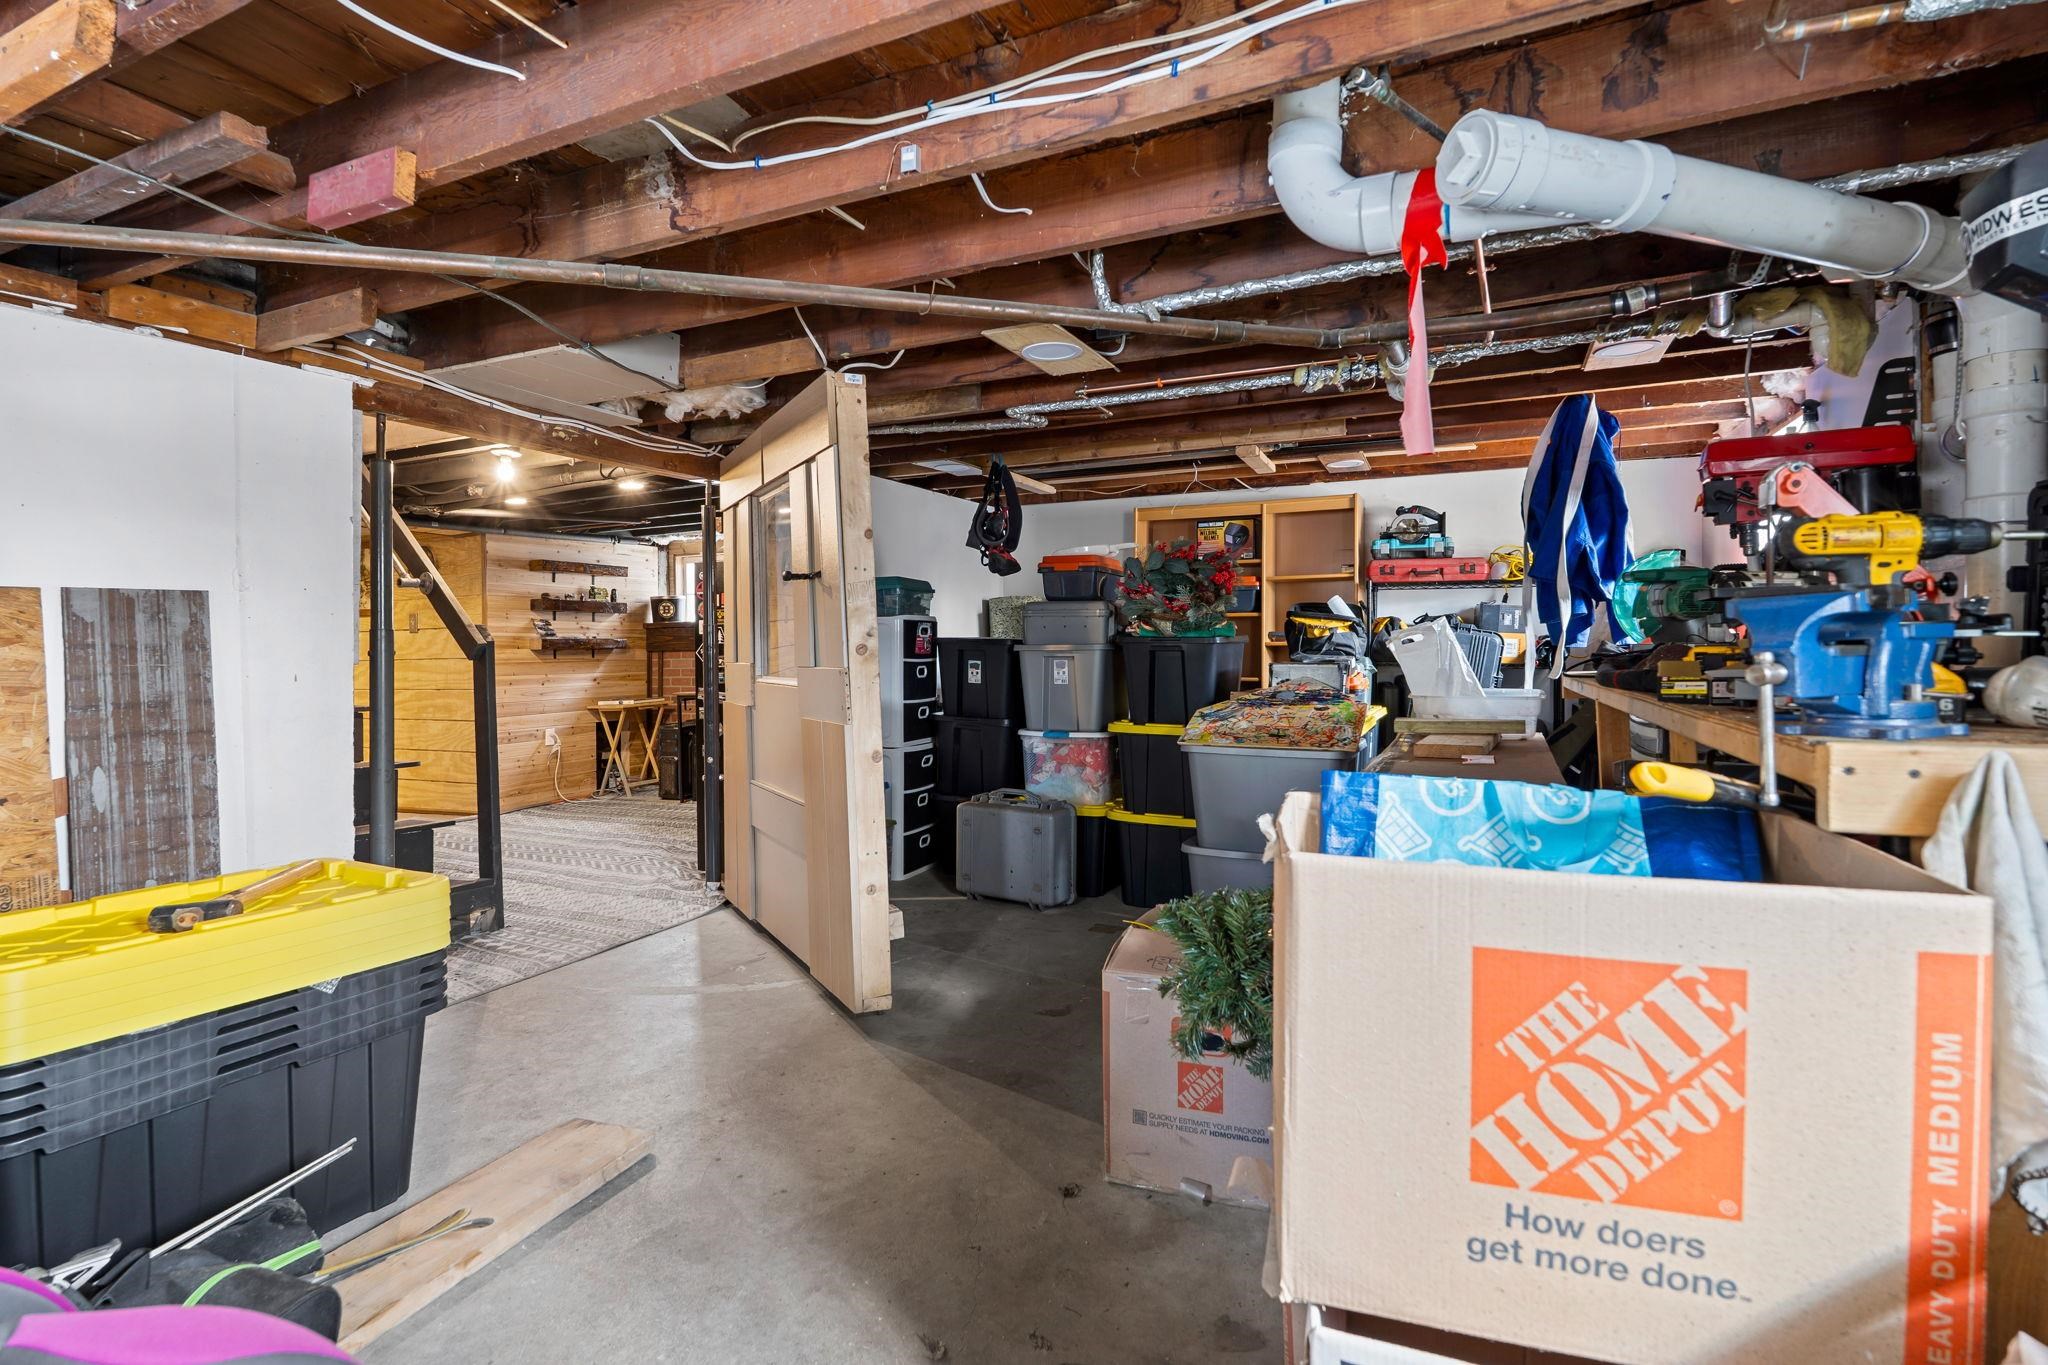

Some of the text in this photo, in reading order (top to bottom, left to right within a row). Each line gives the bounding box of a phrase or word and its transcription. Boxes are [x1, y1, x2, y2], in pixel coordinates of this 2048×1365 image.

[1495, 981, 1610, 1073] THE
[1178, 1066, 1222, 1109] HOME
[1184, 1068, 1199, 1086] THE
[1195, 1086, 1223, 1111] DEPOT
[1470, 963, 1746, 1191] HOME
[1149, 1112, 1265, 1137] QUICKLY ESTIMATE YOUR PACKING
[1149, 1120, 1174, 1130] SUPPLY
[1175, 1124, 1198, 1135] NEEDS
[1209, 1130, 1270, 1145] HDMOVING.COM
[1572, 1060, 1747, 1204] DEPOT
[1928, 1032, 1963, 1188] MEDIUM
[1504, 1202, 1706, 1260] How doers
[1931, 1200, 1958, 1281] DUTY
[1465, 1236, 1523, 1263] get
[1534, 1249, 1629, 1282] more
